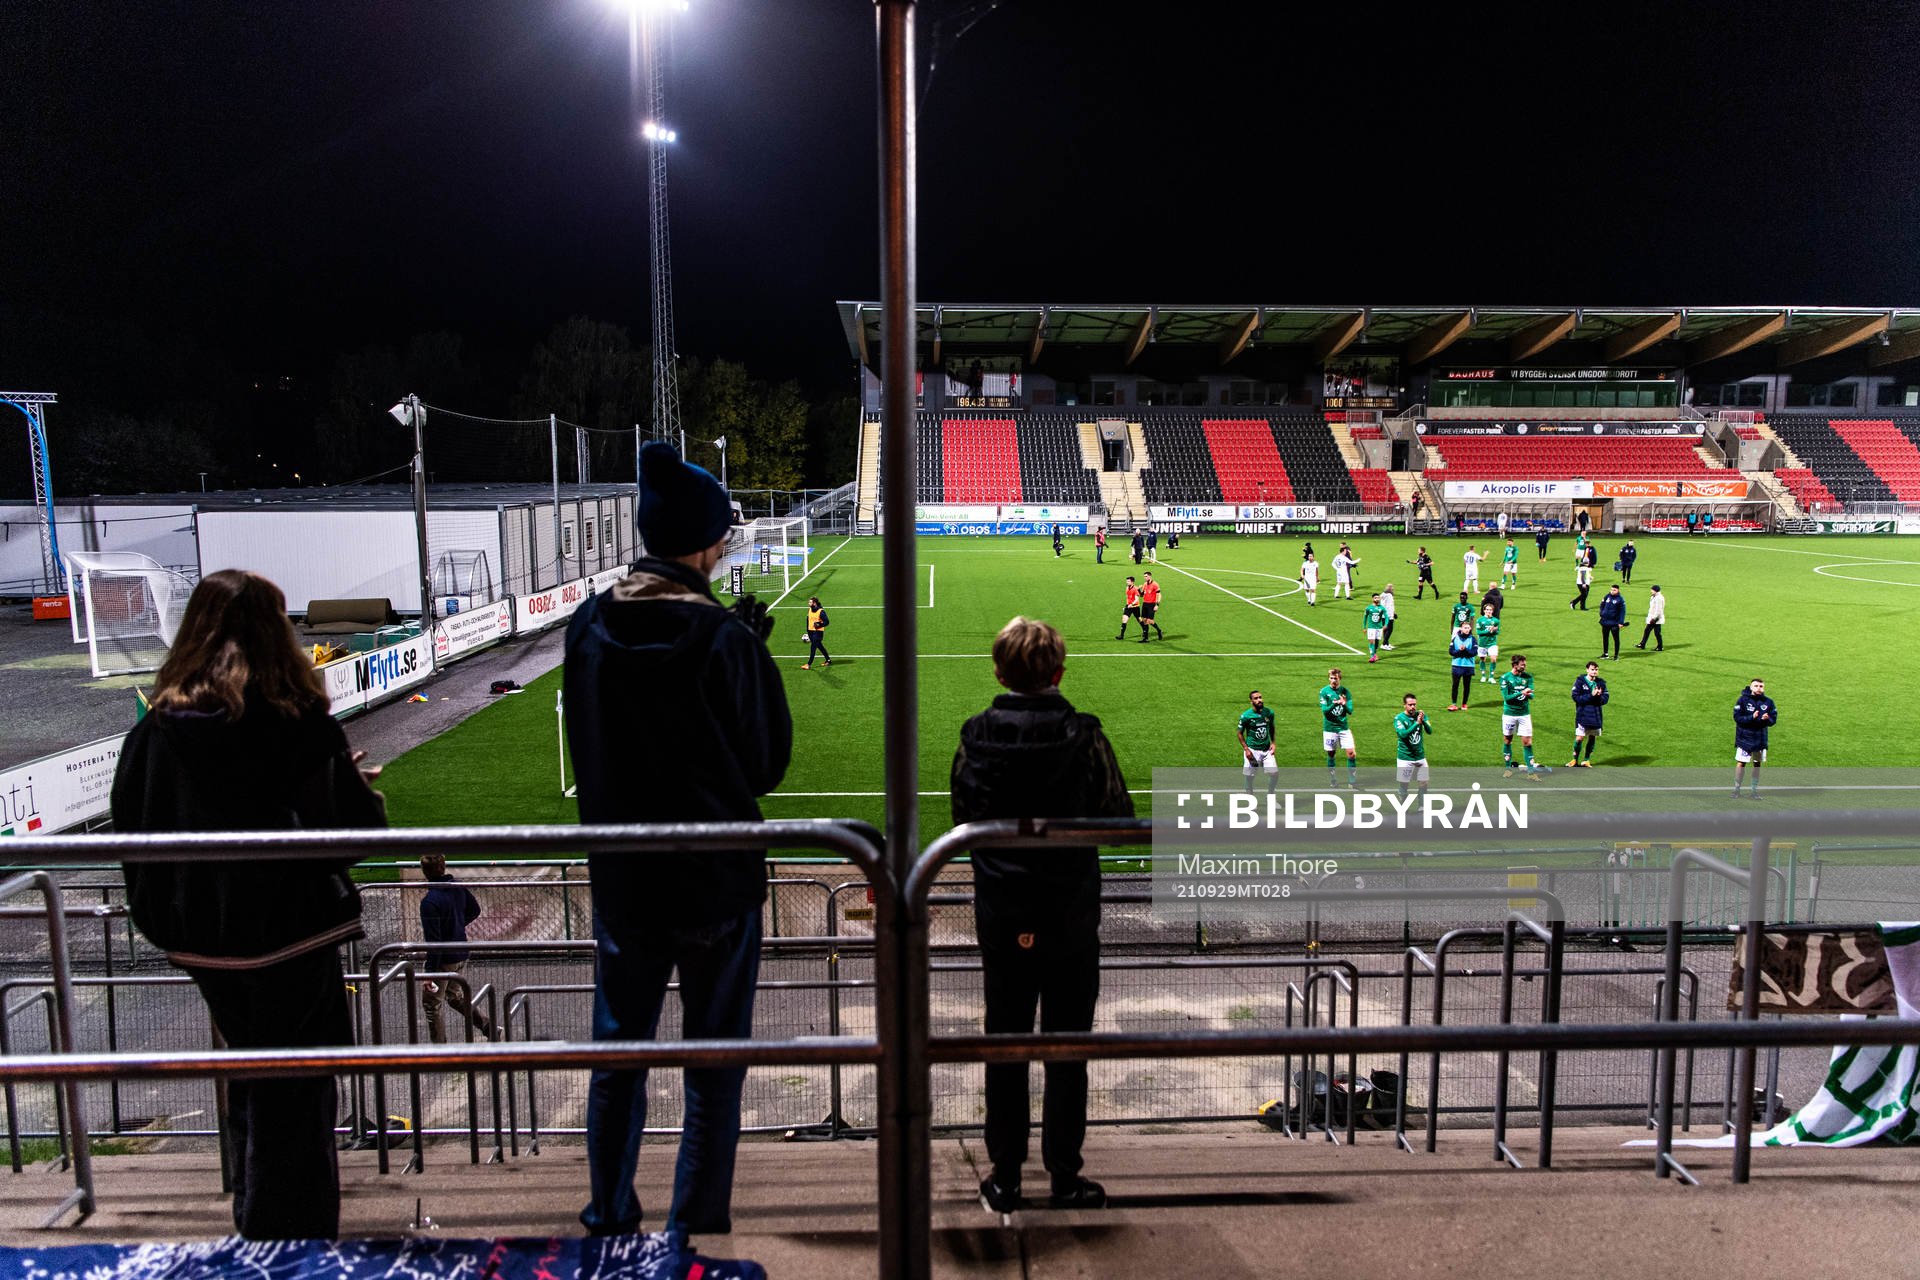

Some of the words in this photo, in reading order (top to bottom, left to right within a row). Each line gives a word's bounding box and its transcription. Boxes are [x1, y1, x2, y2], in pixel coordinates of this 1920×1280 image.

[1511, 370, 1518, 378] VI
[1481, 484, 1540, 494] Akropolis
[1545, 484, 1556, 493] IF
[1167, 507, 1213, 519] MFlytt.se
[1253, 507, 1273, 518] BSIS
[1296, 507, 1316, 518] BSIS
[961, 526, 990, 534] OBOS
[1152, 522, 1200, 533] UNIBET
[1235, 523, 1284, 533] UNIBET
[1321, 523, 1369, 533] UNIBET
[355, 648, 417, 693] MFlytt.se
